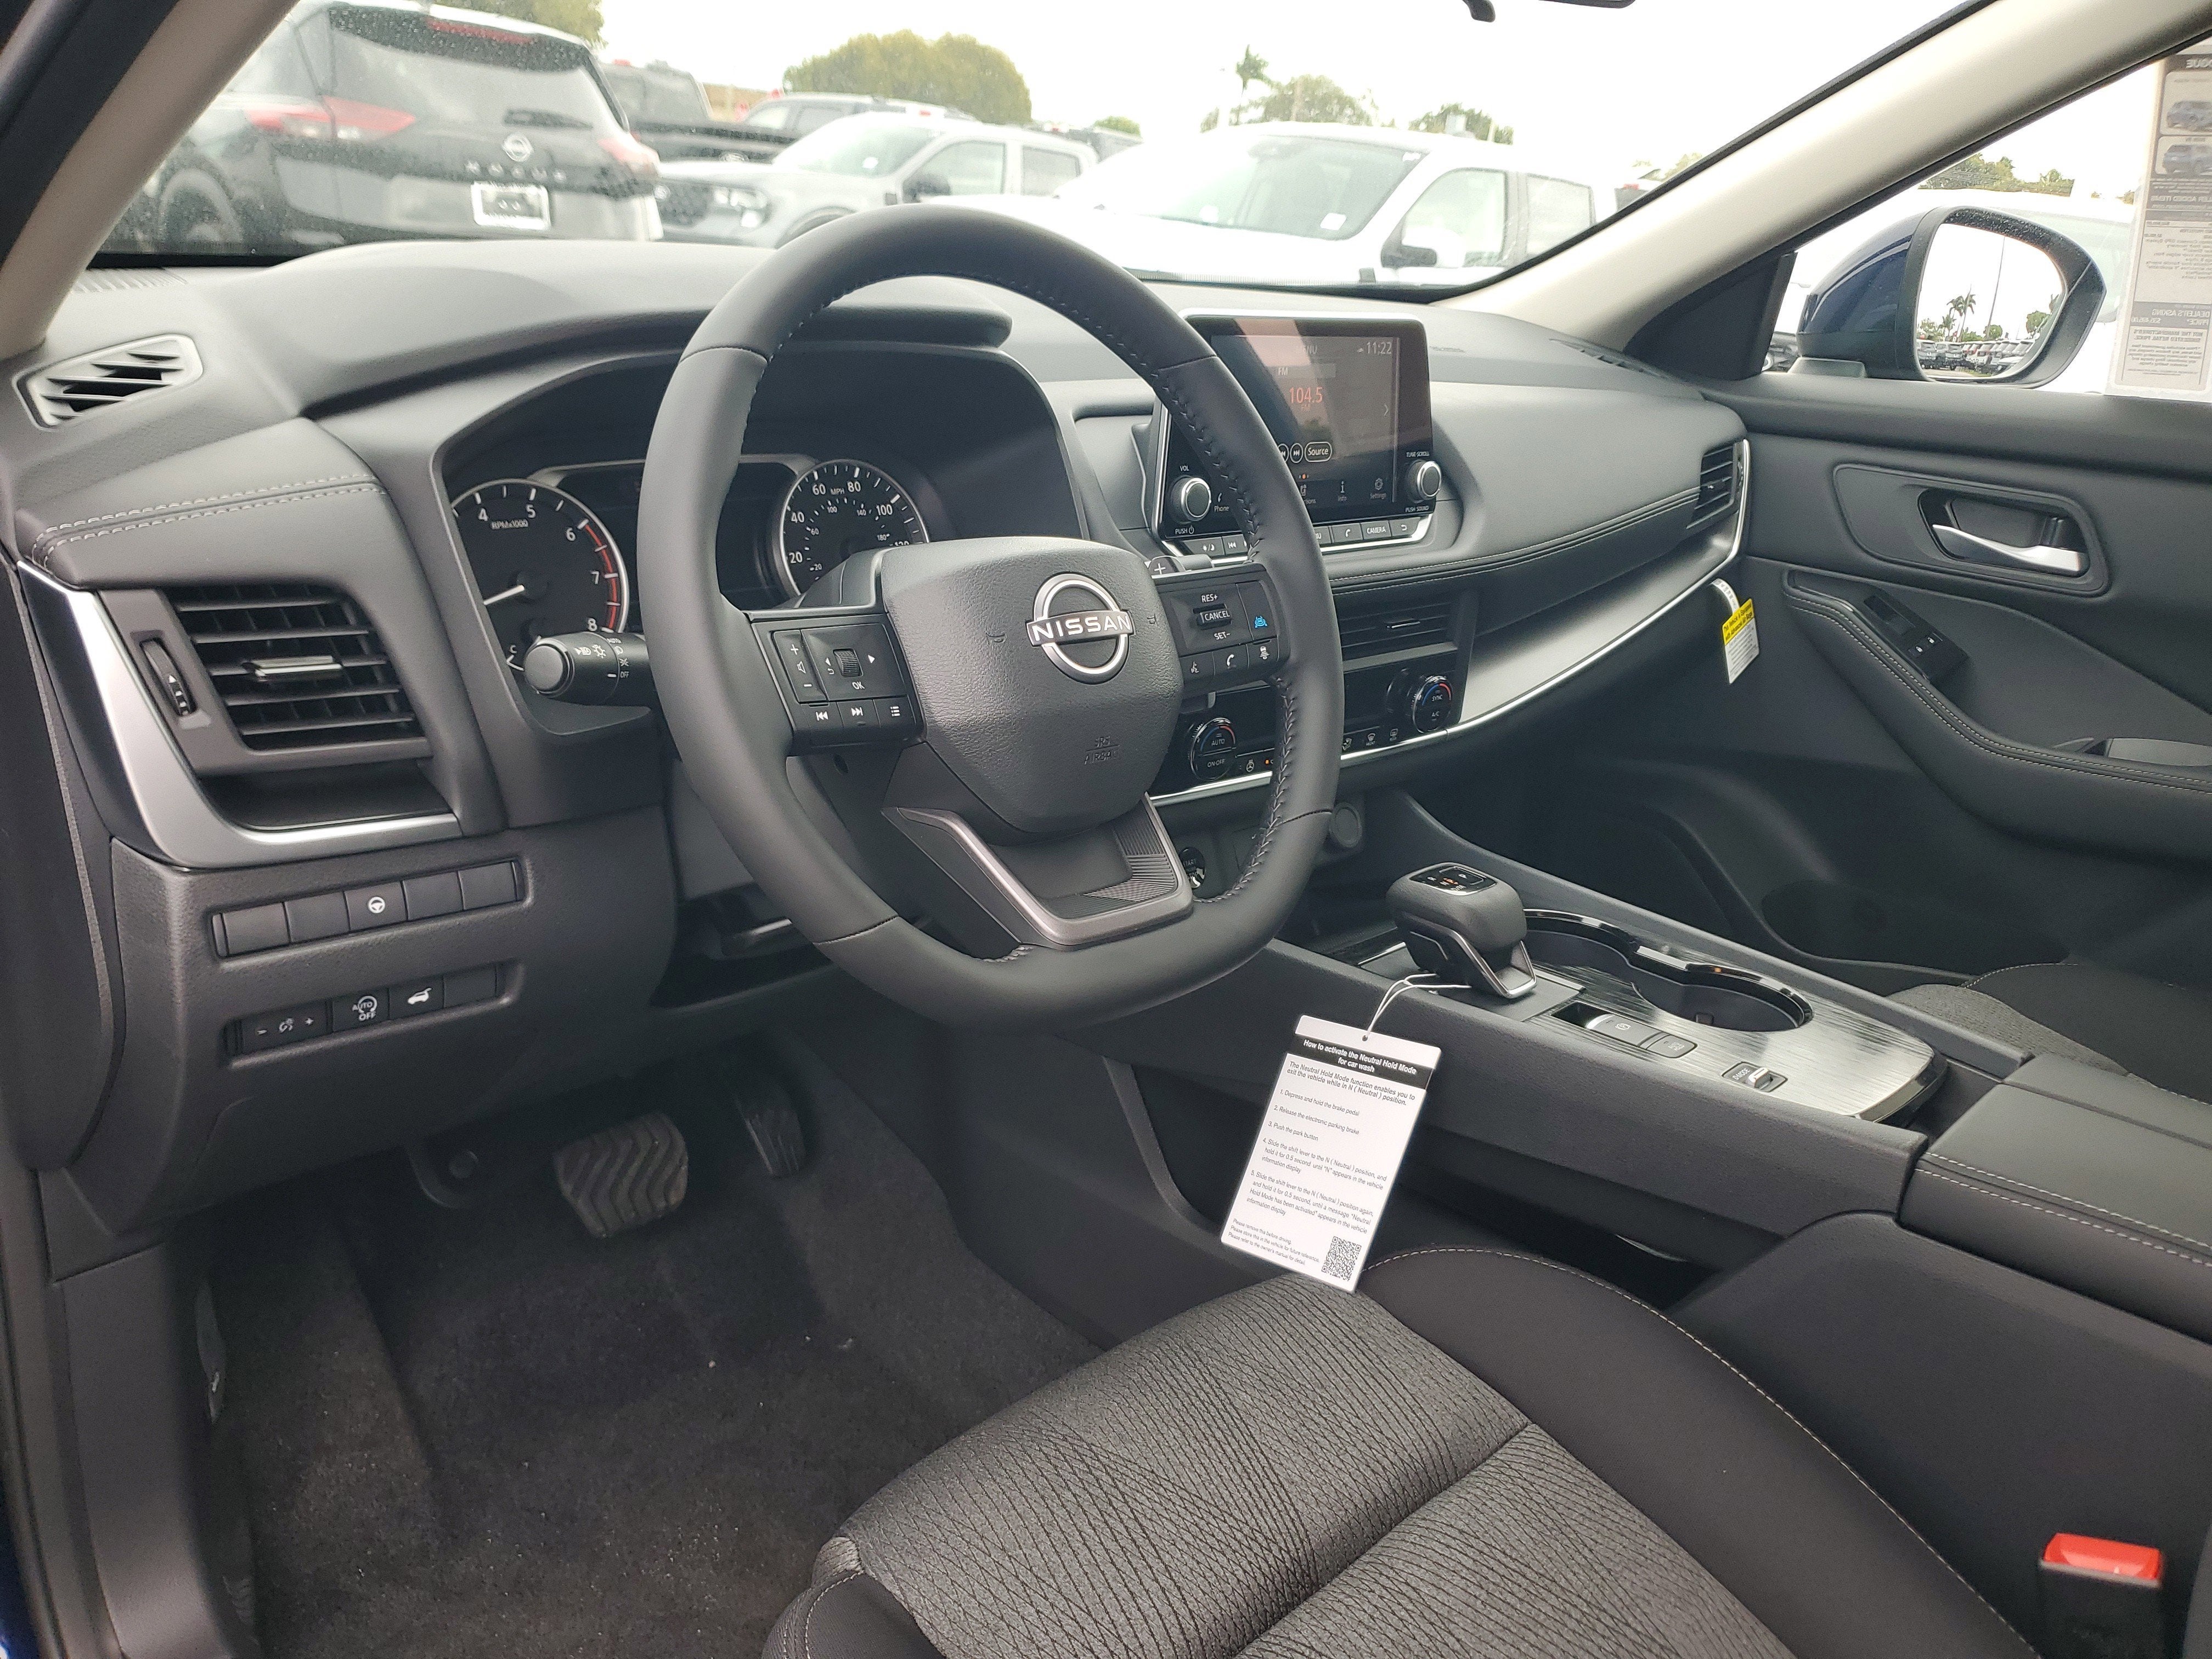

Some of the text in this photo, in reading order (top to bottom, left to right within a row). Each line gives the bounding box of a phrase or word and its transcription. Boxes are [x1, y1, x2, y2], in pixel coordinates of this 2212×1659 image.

[1367, 341, 1391, 356] 11:22
[1289, 387, 1323, 404] 104.5
[1308, 447, 1329, 458] Source
[812, 484, 826, 496] 60
[831, 487, 845, 495] MPH
[847, 481, 861, 493] 80
[526, 504, 537, 518] 5
[856, 508, 867, 516] 140
[876, 504, 894, 516] 100
[1214, 505, 1229, 513] Phone
[478, 509, 489, 522] 4
[791, 511, 805, 523] 40
[566, 528, 577, 542] 6
[1366, 525, 1386, 534] CAMERA
[788, 551, 803, 564] 20
[590, 570, 600, 585] 7
[1201, 592, 1218, 603] RES+
[1205, 610, 1230, 620] CANCEL
[588, 618, 597, 633] 8
[1032, 615, 1133, 642] NISSAN
[853, 680, 865, 690] OK
[1211, 737, 1226, 747] AUTO
[352, 1001, 374, 1012] AUTO
[359, 1011, 376, 1022] OFF
[1303, 1040, 1317, 1048] How
[1324, 1046, 1347, 1057] activate
[1347, 1051, 1358, 1059] the
[1358, 1053, 1383, 1065] Neutral
[1382, 1059, 1398, 1069] Hold
[1398, 1063, 1417, 1074] Mode
[1338, 1057, 1346, 1065] for
[1358, 1063, 1375, 1073] wash
[1300, 1064, 1320, 1074] Neutral
[1320, 1069, 1334, 1077] Hold
[1334, 1073, 1350, 1082] Mode
[1350, 1077, 1373, 1088] function
[1374, 1085, 1396, 1095] enables
[1307, 1074, 1325, 1083] vehicle
[1327, 1079, 1341, 1087] while
[1357, 1087, 1378, 1097] Neutral
[1382, 1094, 1406, 1105] position.
